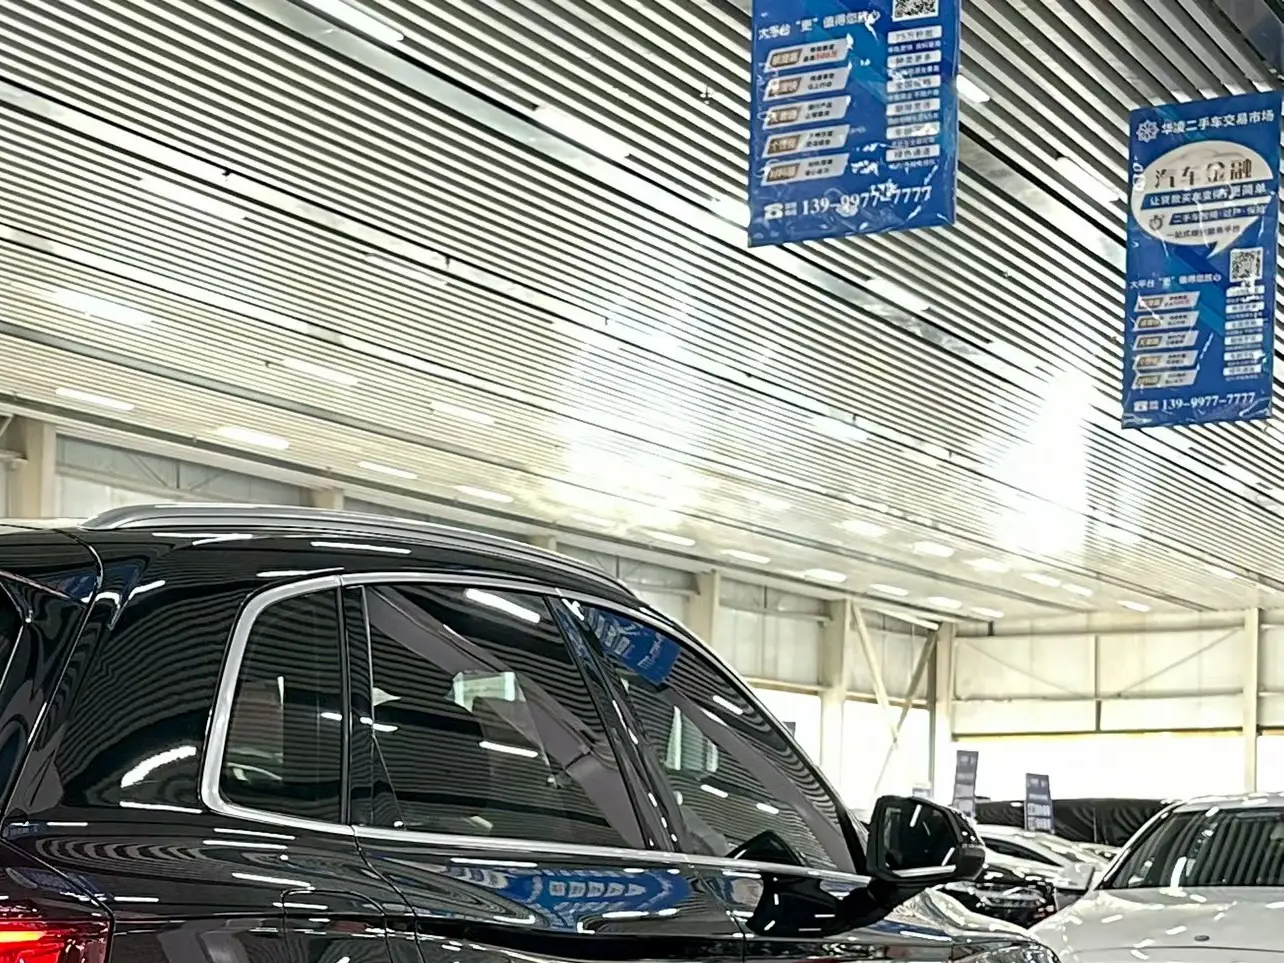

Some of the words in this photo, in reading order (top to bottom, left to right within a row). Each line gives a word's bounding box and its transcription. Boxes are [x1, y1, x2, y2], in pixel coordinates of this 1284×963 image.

[1161, 109, 1275, 135] 华凌二手车交易市场
[1154, 158, 1253, 189] 汽车金融
[1161, 391, 1256, 411] 139-9977-7777
